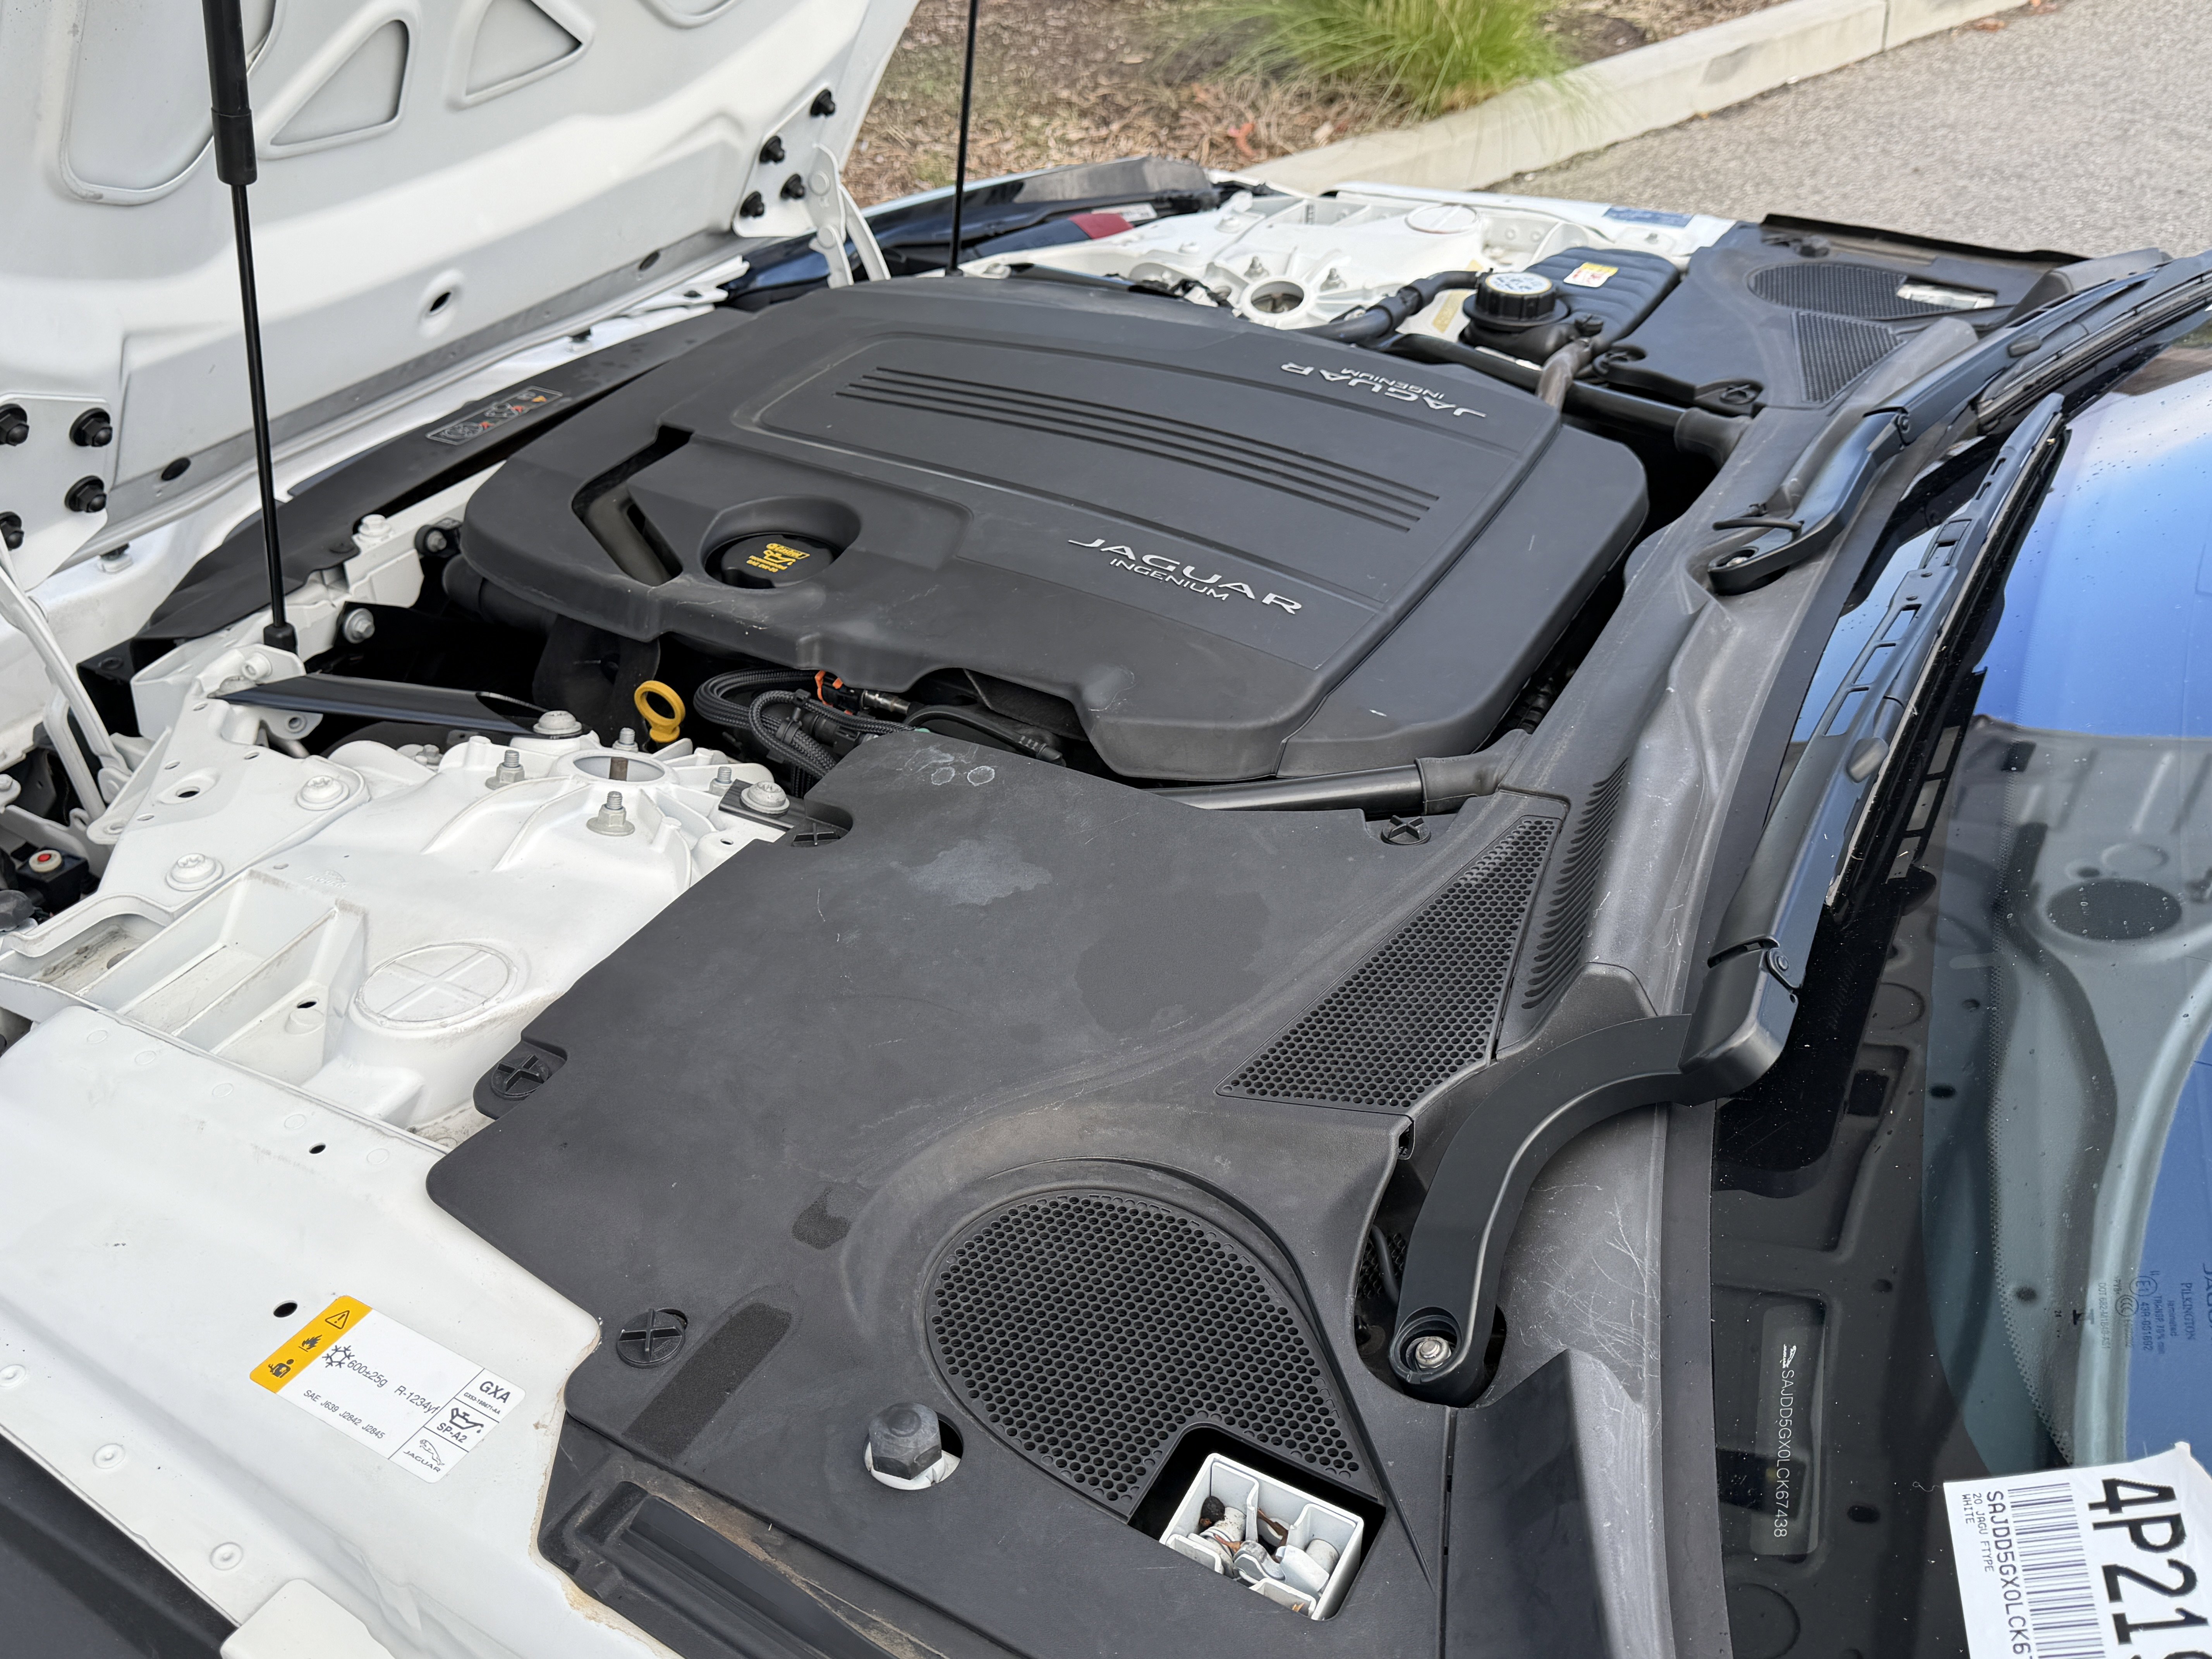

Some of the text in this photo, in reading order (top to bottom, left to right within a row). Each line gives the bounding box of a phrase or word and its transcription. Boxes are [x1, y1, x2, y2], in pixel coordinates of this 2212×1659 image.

[1280, 362, 1487, 417] JAGUAR
[1340, 368, 1445, 400] INGENIUM
[1068, 538, 1302, 615] JAGUAR
[1110, 558, 1229, 601] INGENIUM
[2098, 1282, 2107, 1295] DOT
[2180, 1282, 2196, 1340] PILKINGTON
[347, 1359, 441, 1414] 600±25g R-1234yf
[479, 1381, 511, 1403] GXA
[303, 1389, 386, 1439] SAE J639 J2842 J2845
[436, 1422, 468, 1443] SP-A2
[403, 1450, 441, 1473] JAGUAR
[1773, 1369, 1795, 1537] SAJDD5GX0LCK67438
[1961, 1493, 1975, 1524] WHITE
[1972, 1492, 1994, 1573] 20 JAGU FTYPE
[1986, 1490, 2033, 1659] SAJDD5GX0LCK6
[2088, 1477, 2212, 1659] 4P21
